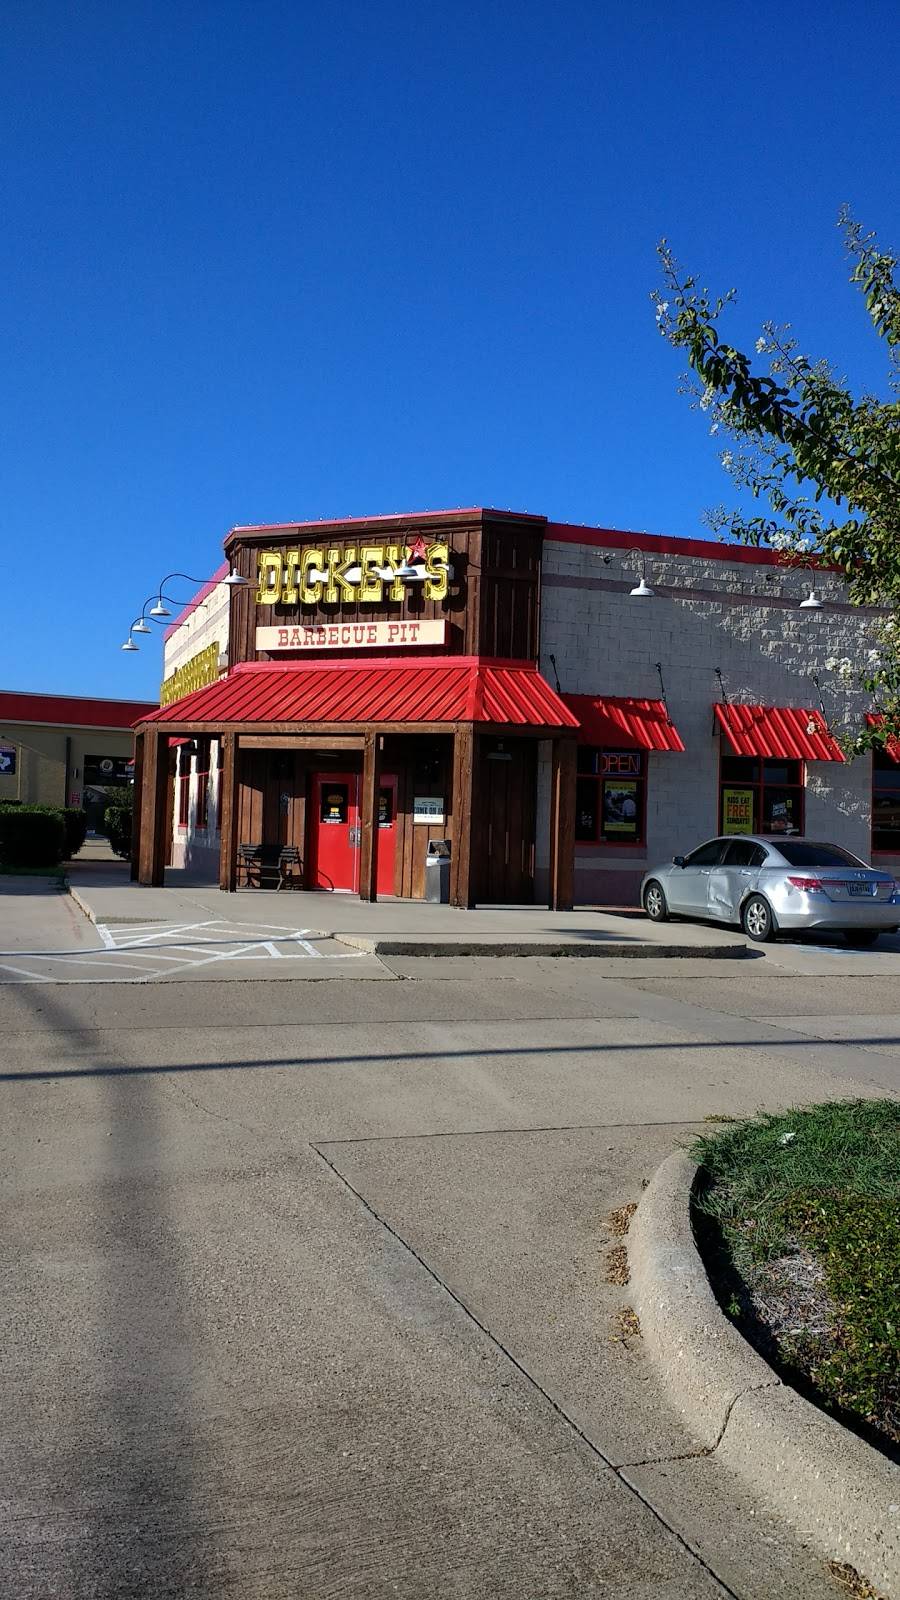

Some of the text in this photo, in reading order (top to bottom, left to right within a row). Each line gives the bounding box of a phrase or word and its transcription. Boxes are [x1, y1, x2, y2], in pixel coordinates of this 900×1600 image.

[256, 542, 449, 605] DICKEY'S
[278, 623, 420, 647] BARBECUE PIT
[599, 754, 639, 773] OPEN
[727, 804, 750, 817] FREE
